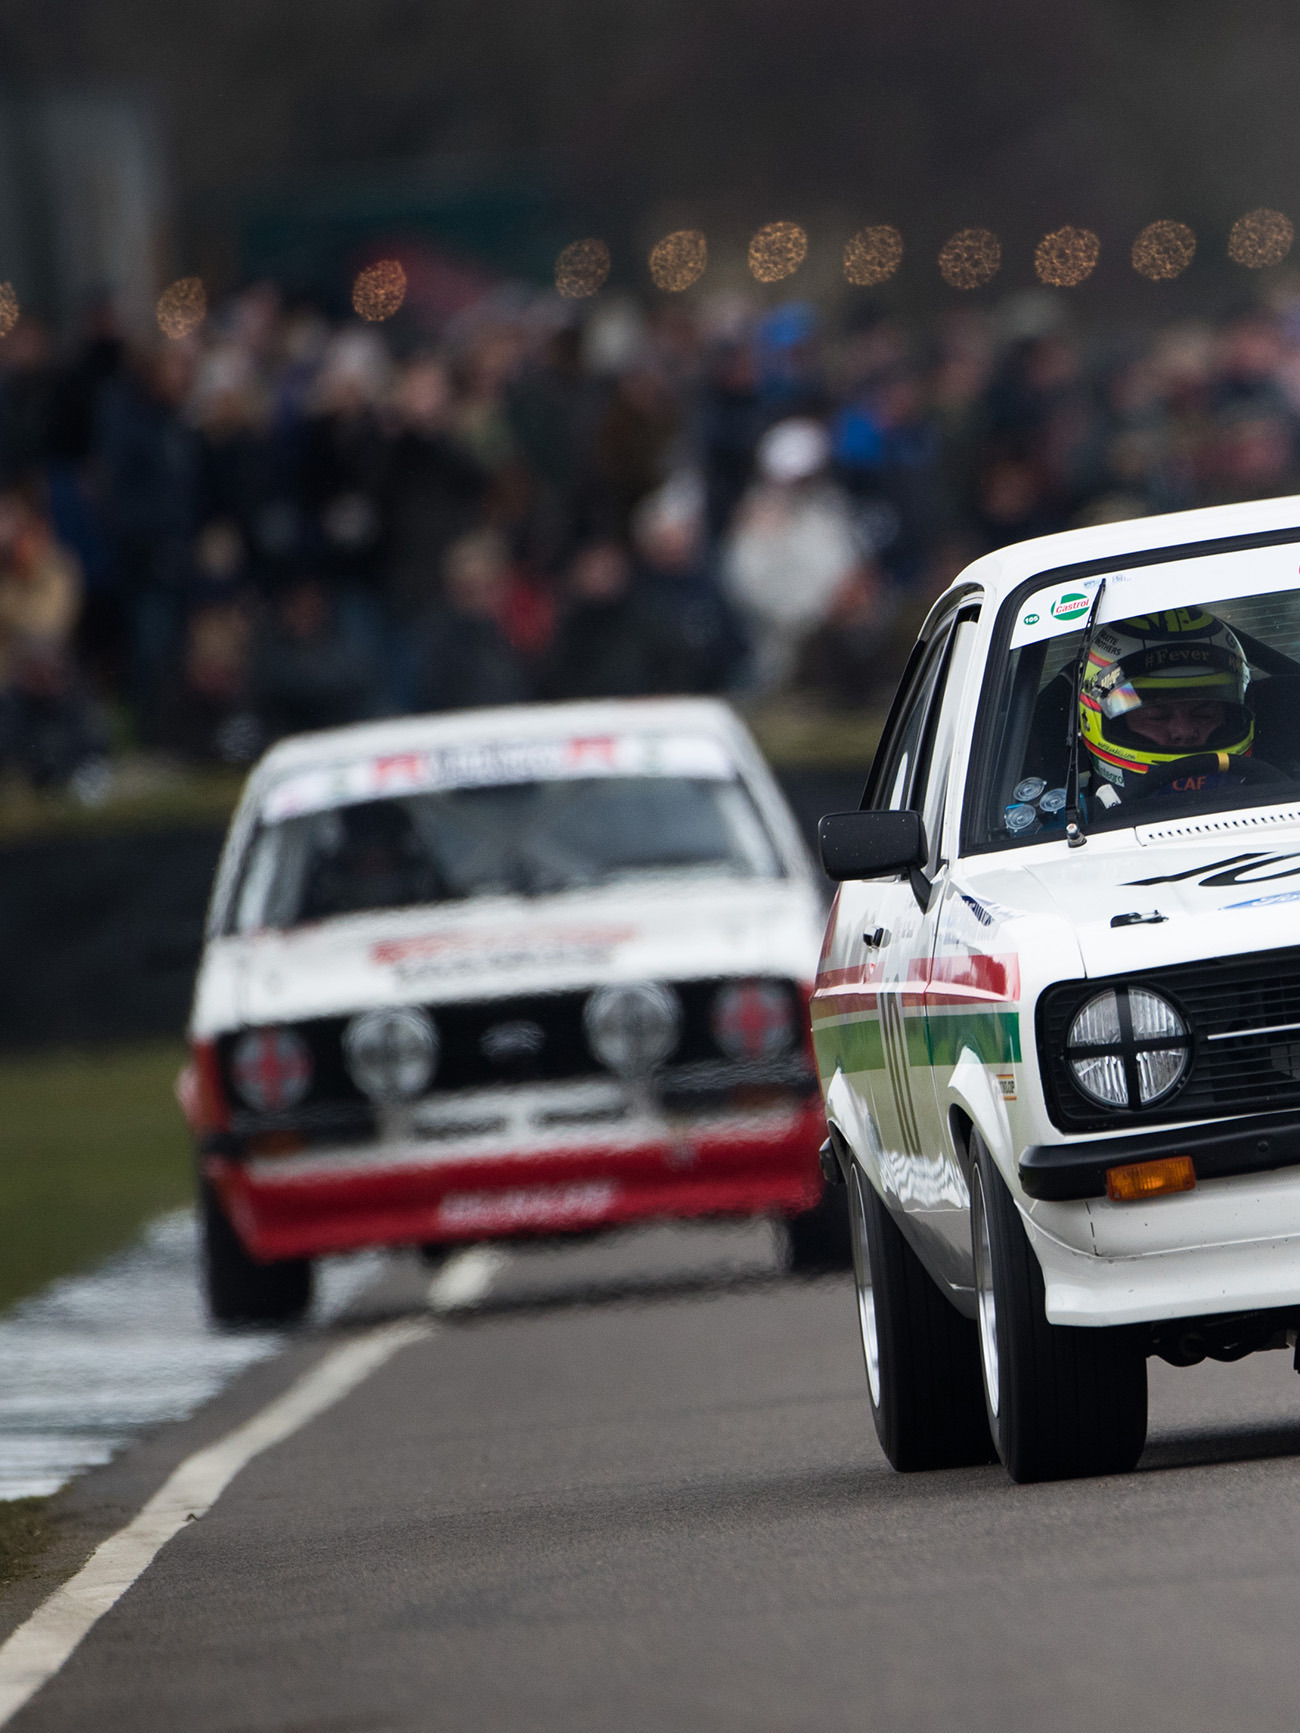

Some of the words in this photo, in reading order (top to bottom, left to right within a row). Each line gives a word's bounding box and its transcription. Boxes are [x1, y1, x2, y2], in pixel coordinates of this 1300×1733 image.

[1055, 598, 1090, 614] Castrol
[1145, 649, 1209, 669] #Fever
[1172, 776, 1208, 791] CAF
